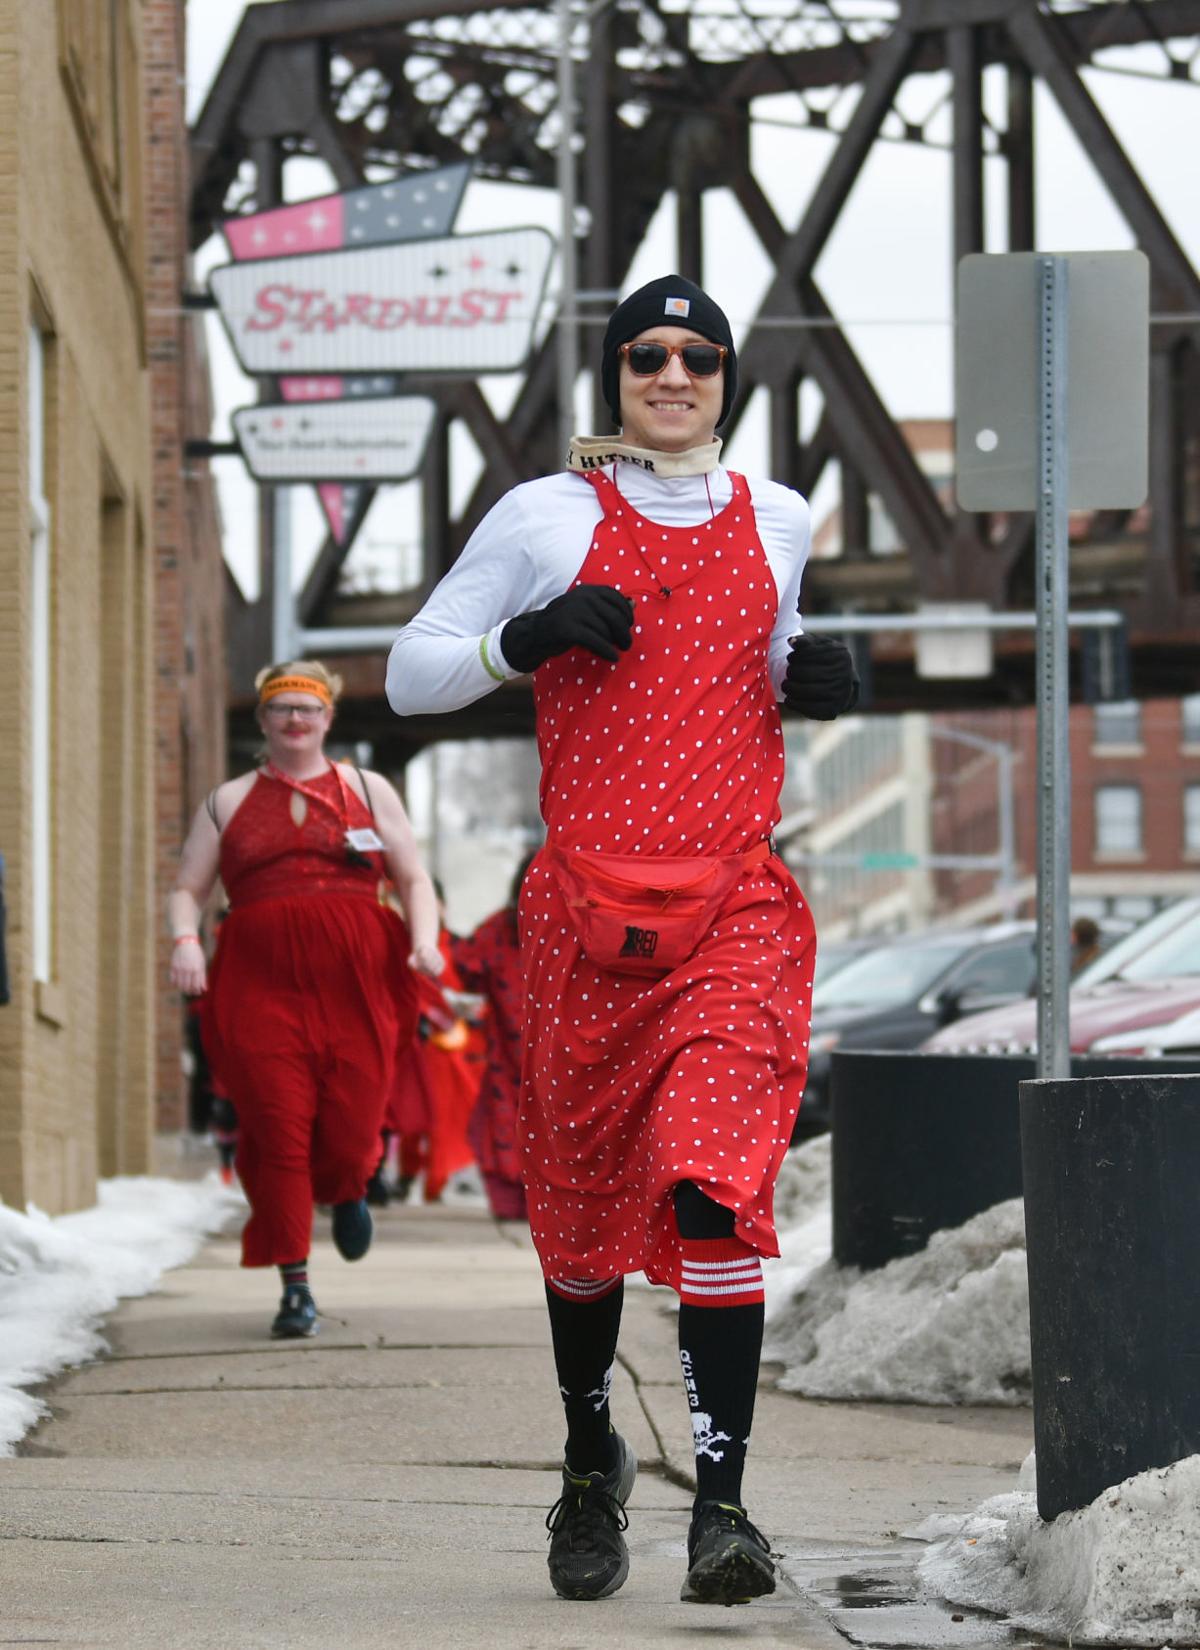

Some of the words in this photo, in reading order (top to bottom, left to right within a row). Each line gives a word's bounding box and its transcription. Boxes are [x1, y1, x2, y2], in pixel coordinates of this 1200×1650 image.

[244, 284, 523, 333] STARDUST
[580, 453, 656, 472] HITTER
[635, 928, 659, 953] RED
[680, 1349, 700, 1407] QCH3
